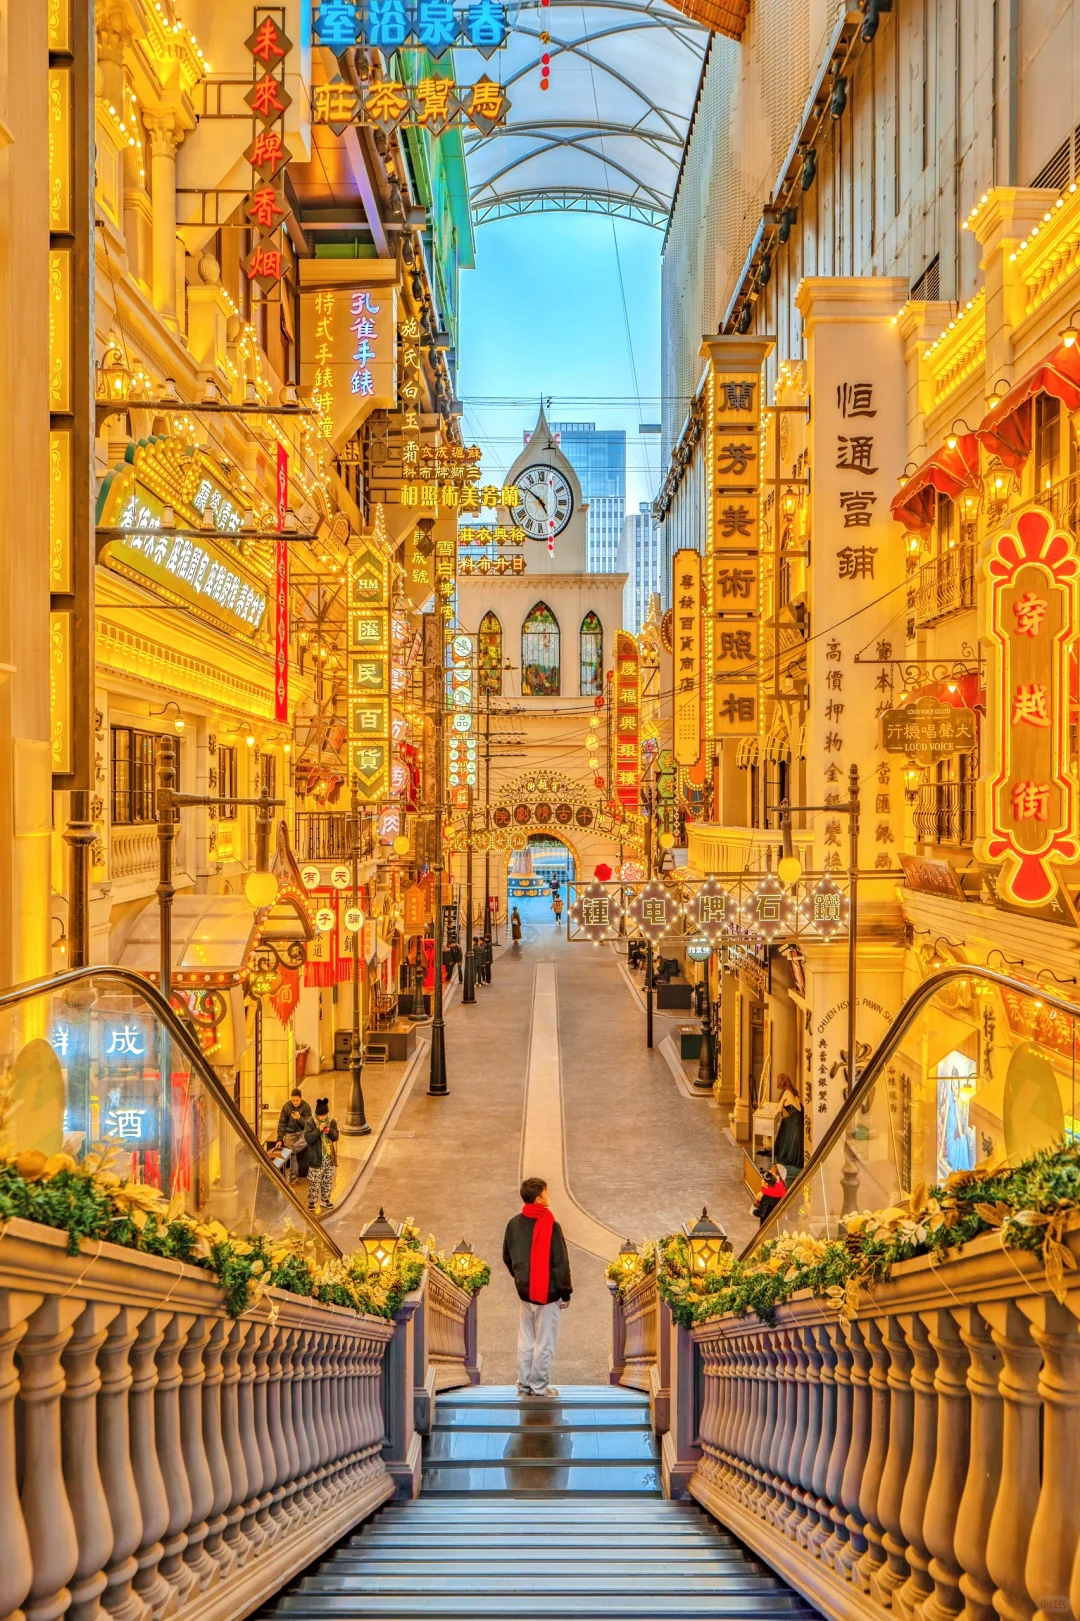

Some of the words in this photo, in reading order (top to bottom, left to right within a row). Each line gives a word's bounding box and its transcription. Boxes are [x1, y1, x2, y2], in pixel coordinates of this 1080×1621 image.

[717, 381, 756, 724] 蘭芳美術照相
[905, 742, 928, 752] LOUD
[930, 741, 955, 752] VOICE
[1012, 596, 1051, 822] 穿越街
[862, 997, 883, 1014] PAWN
